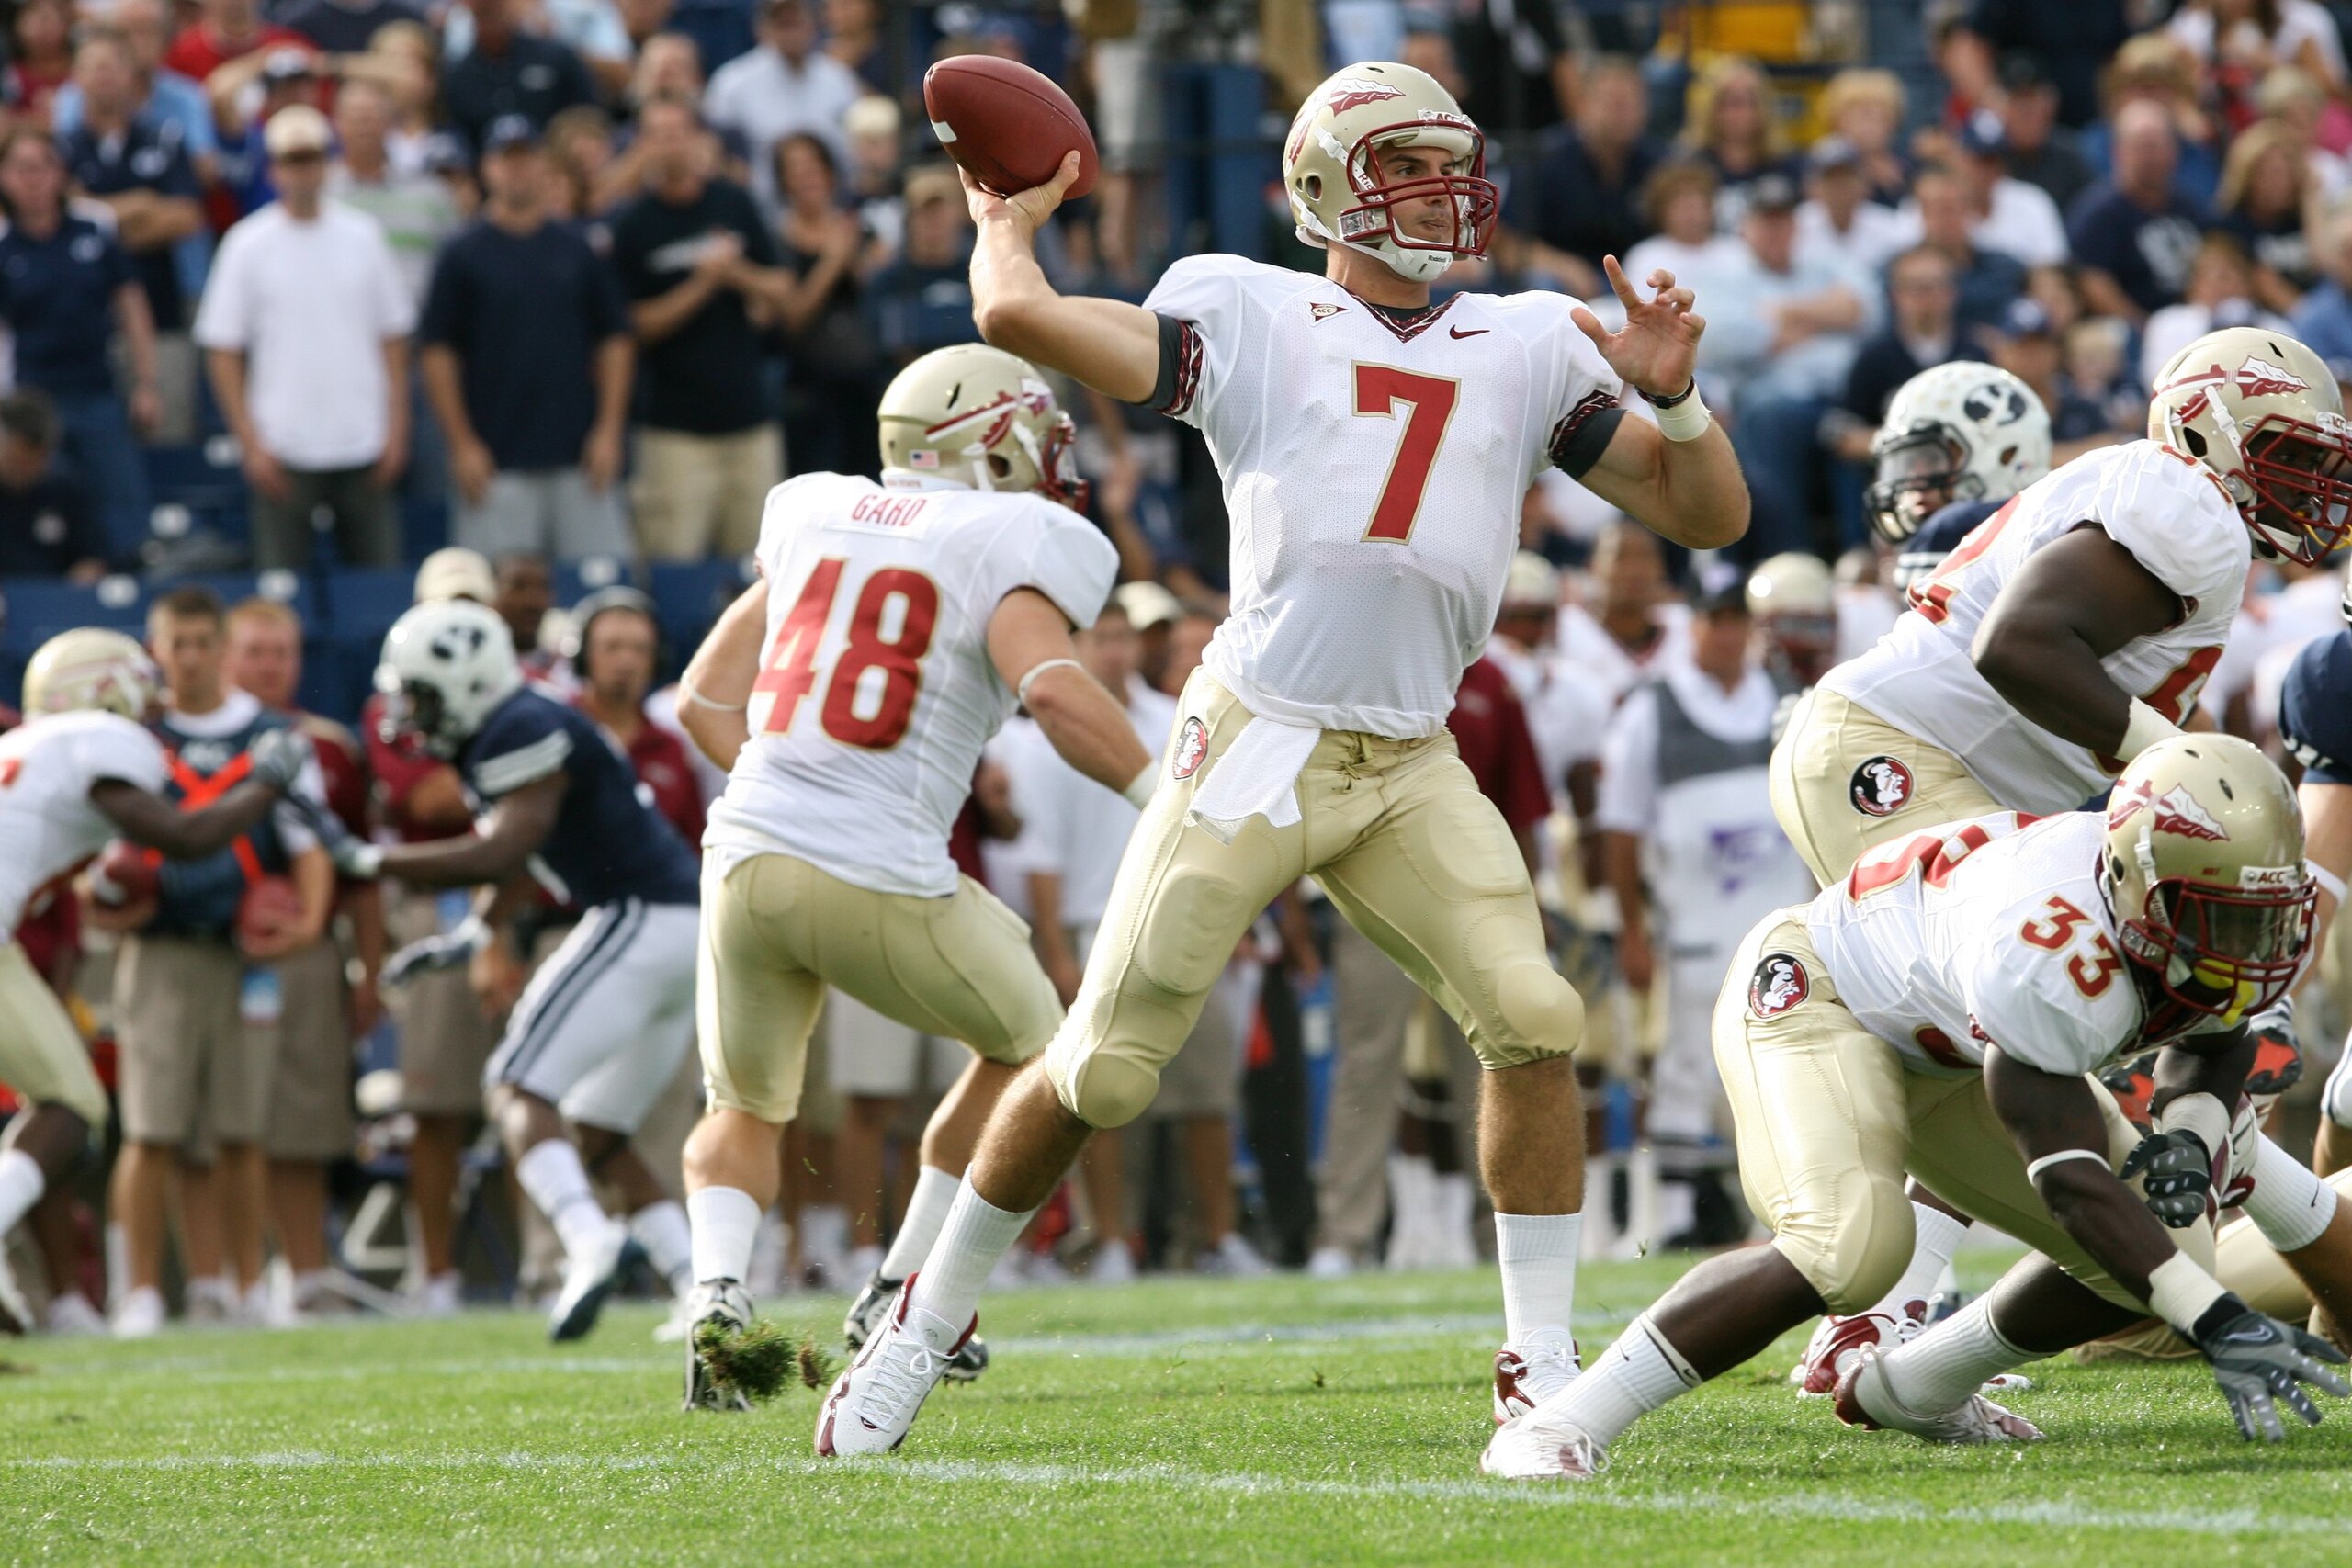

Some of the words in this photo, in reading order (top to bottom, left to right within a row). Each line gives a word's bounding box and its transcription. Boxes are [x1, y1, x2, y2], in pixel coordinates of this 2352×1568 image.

[1351, 359, 1462, 546] 7
[750, 557, 944, 753] 48
[2017, 891, 2128, 1003] 33
[2257, 871, 2286, 883] ACC
